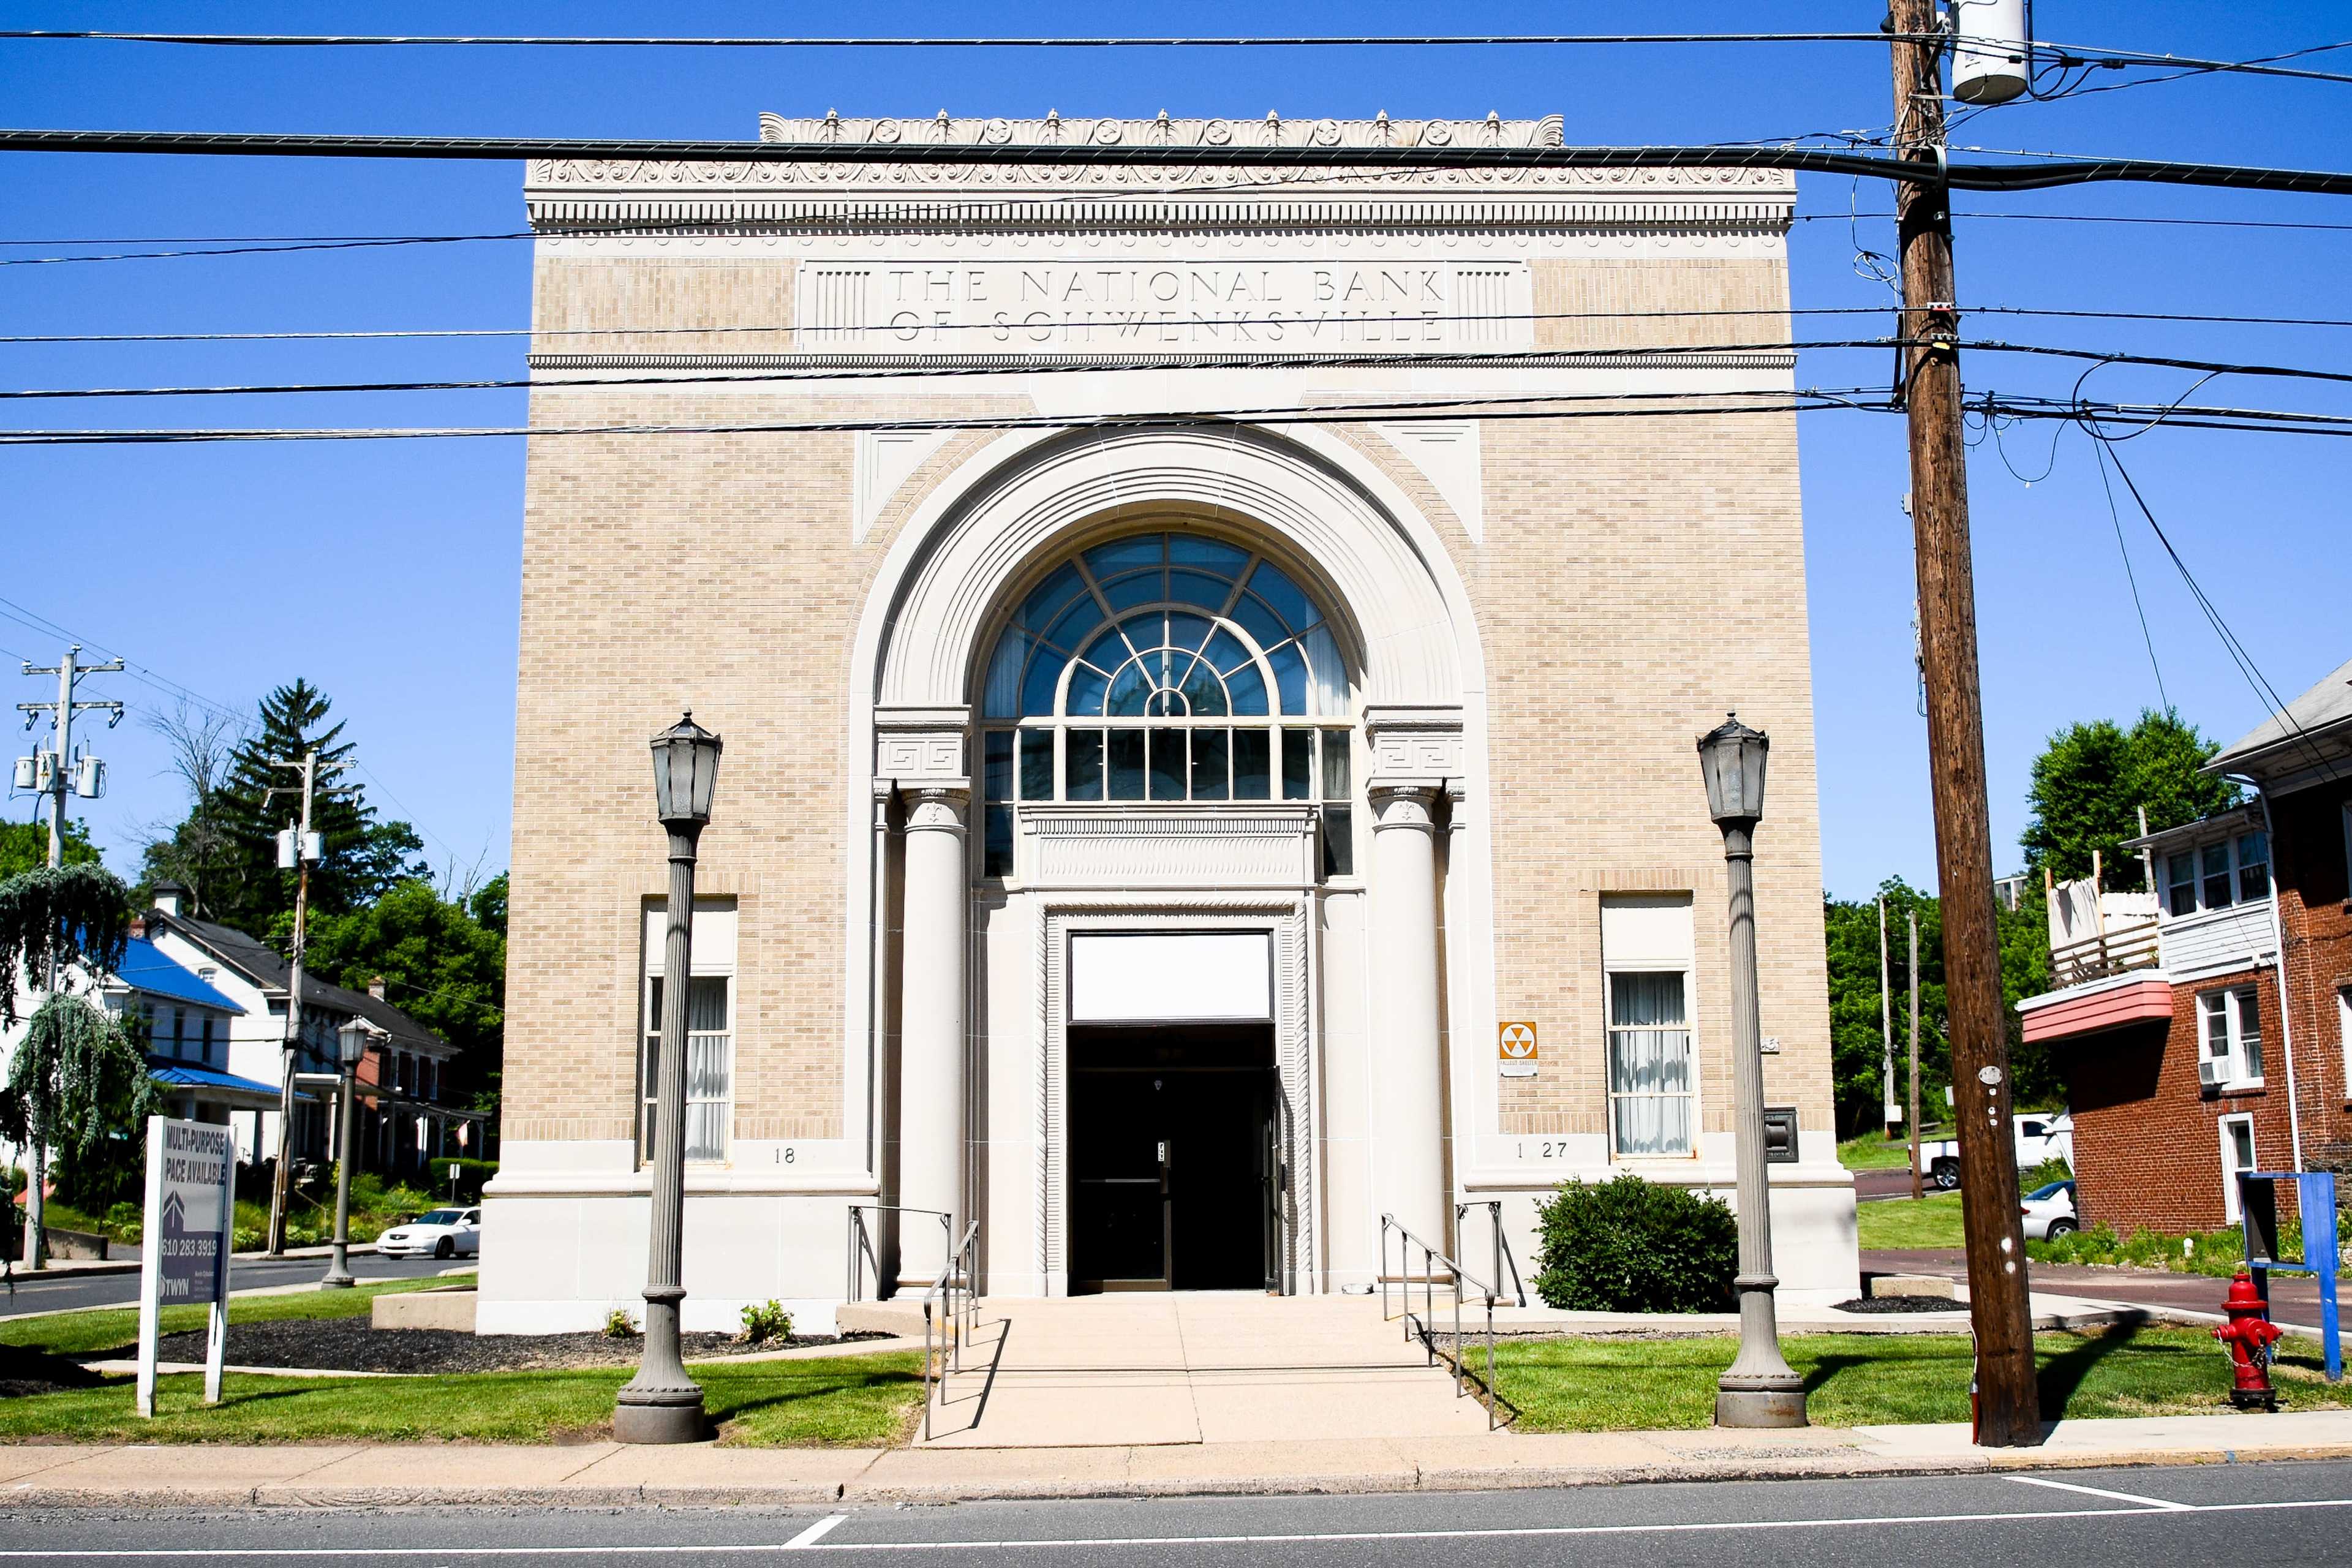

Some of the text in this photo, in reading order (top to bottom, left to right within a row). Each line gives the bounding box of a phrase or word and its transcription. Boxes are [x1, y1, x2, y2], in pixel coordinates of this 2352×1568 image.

[889, 271, 1445, 301] THE NATIONAL BANK
[891, 311, 1442, 341] OF SCHWENKSVILLE
[167, 1125, 224, 1155] MULTI-PURPOSE
[776, 1148, 794, 1164] 18
[187, 1160, 226, 1186] AVAILABLE
[162, 1238, 217, 1256] 610 283 3919
[166, 1278, 189, 1296] TWYN
